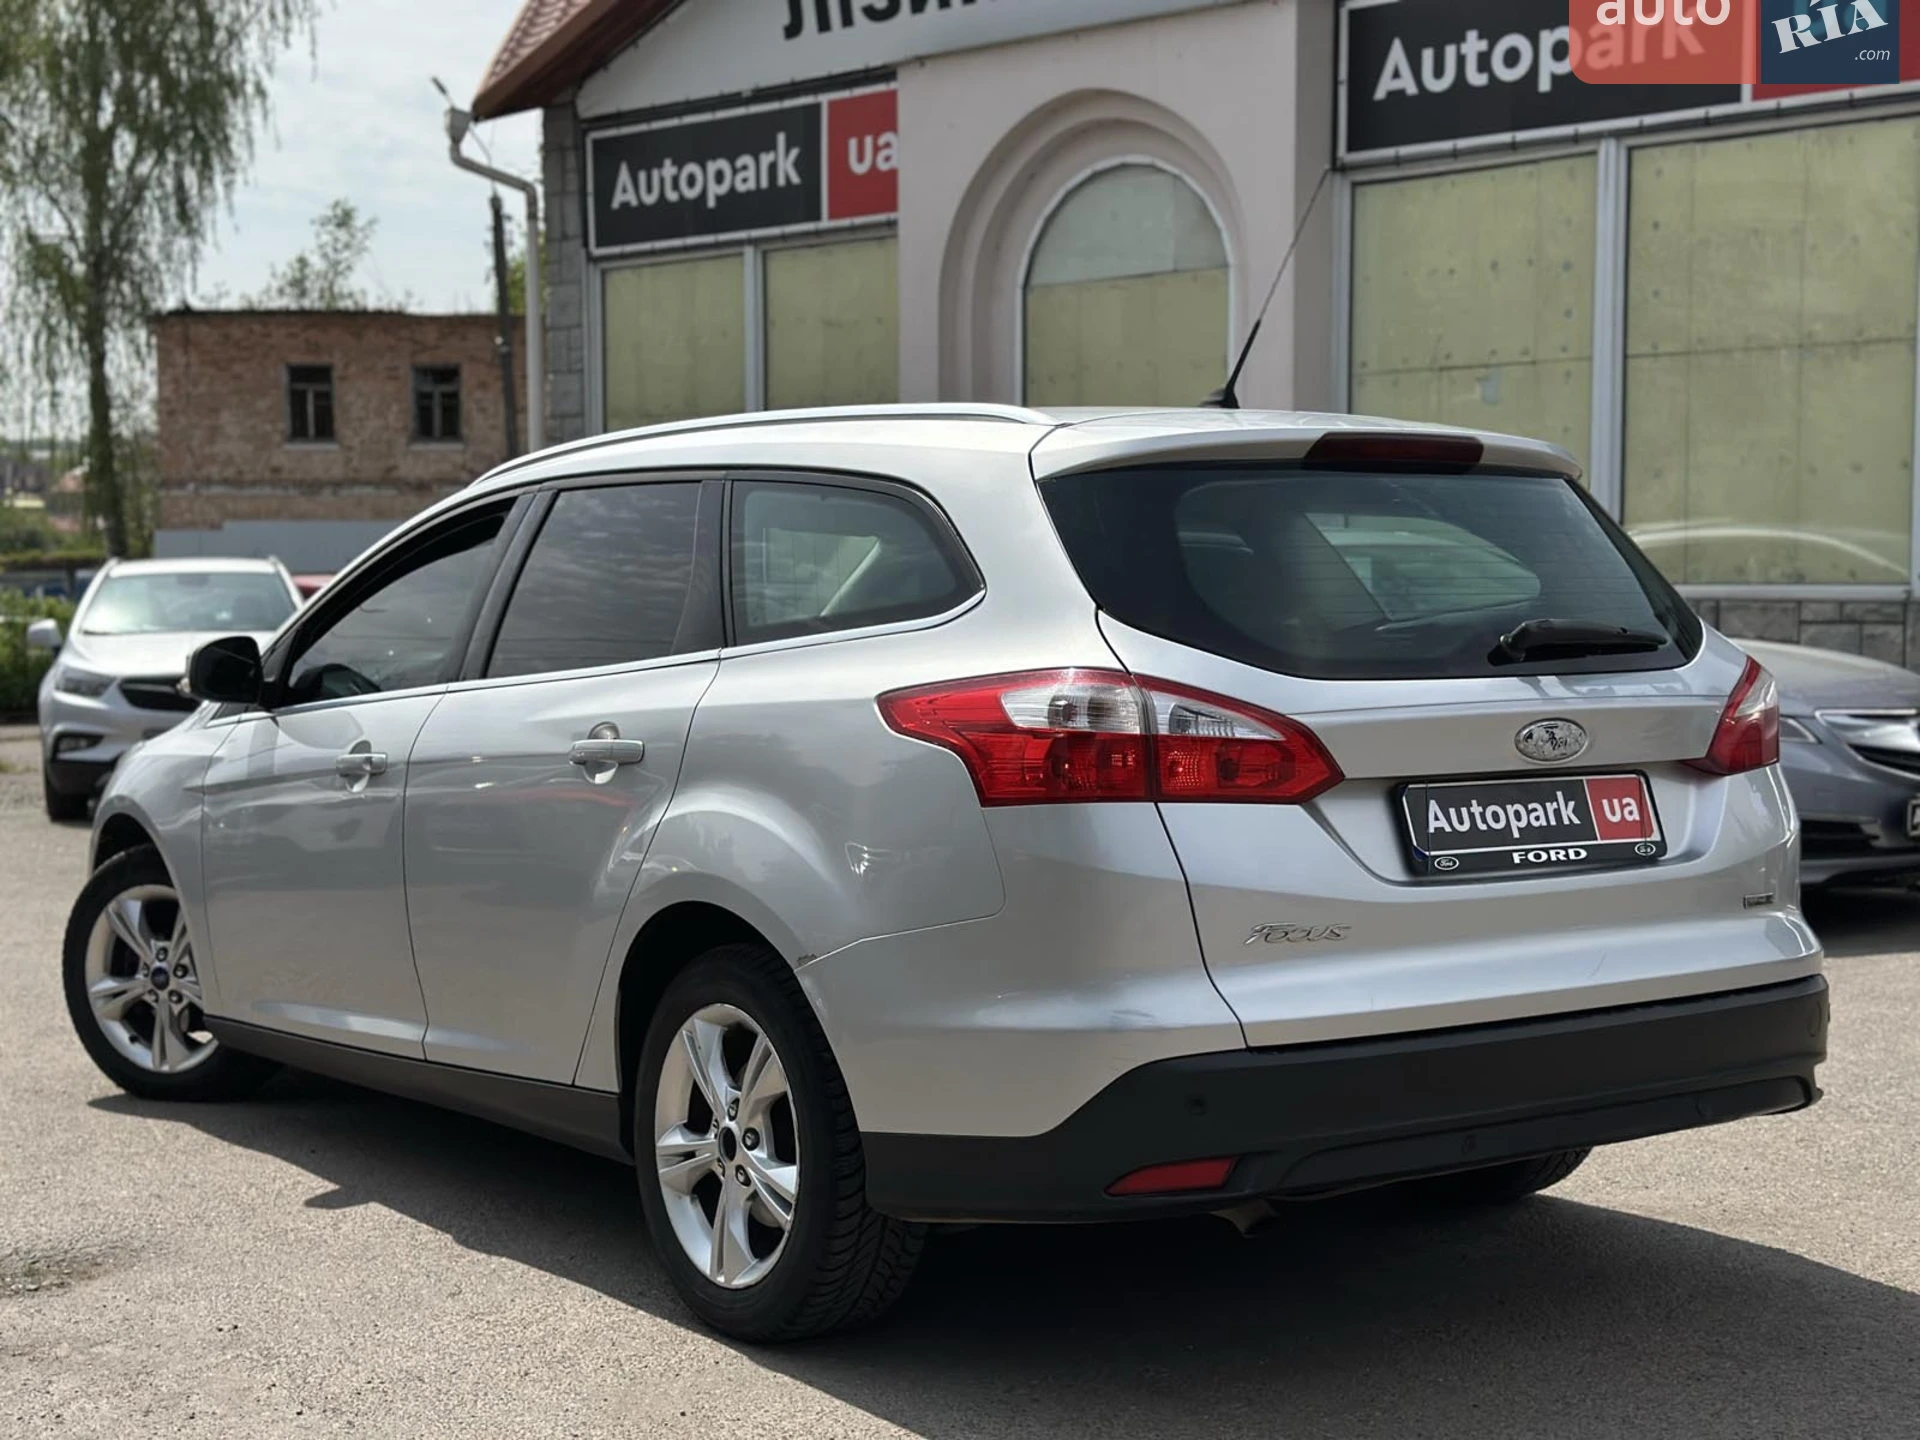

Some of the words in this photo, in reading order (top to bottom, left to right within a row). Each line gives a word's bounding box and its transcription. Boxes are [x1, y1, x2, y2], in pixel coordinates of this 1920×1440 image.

[611, 131, 801, 210] Autopark
[848, 130, 899, 175] ua
[1427, 791, 1581, 839] Autopark
[1602, 796, 1640, 823] ua
[1512, 848, 1588, 864] FORD
